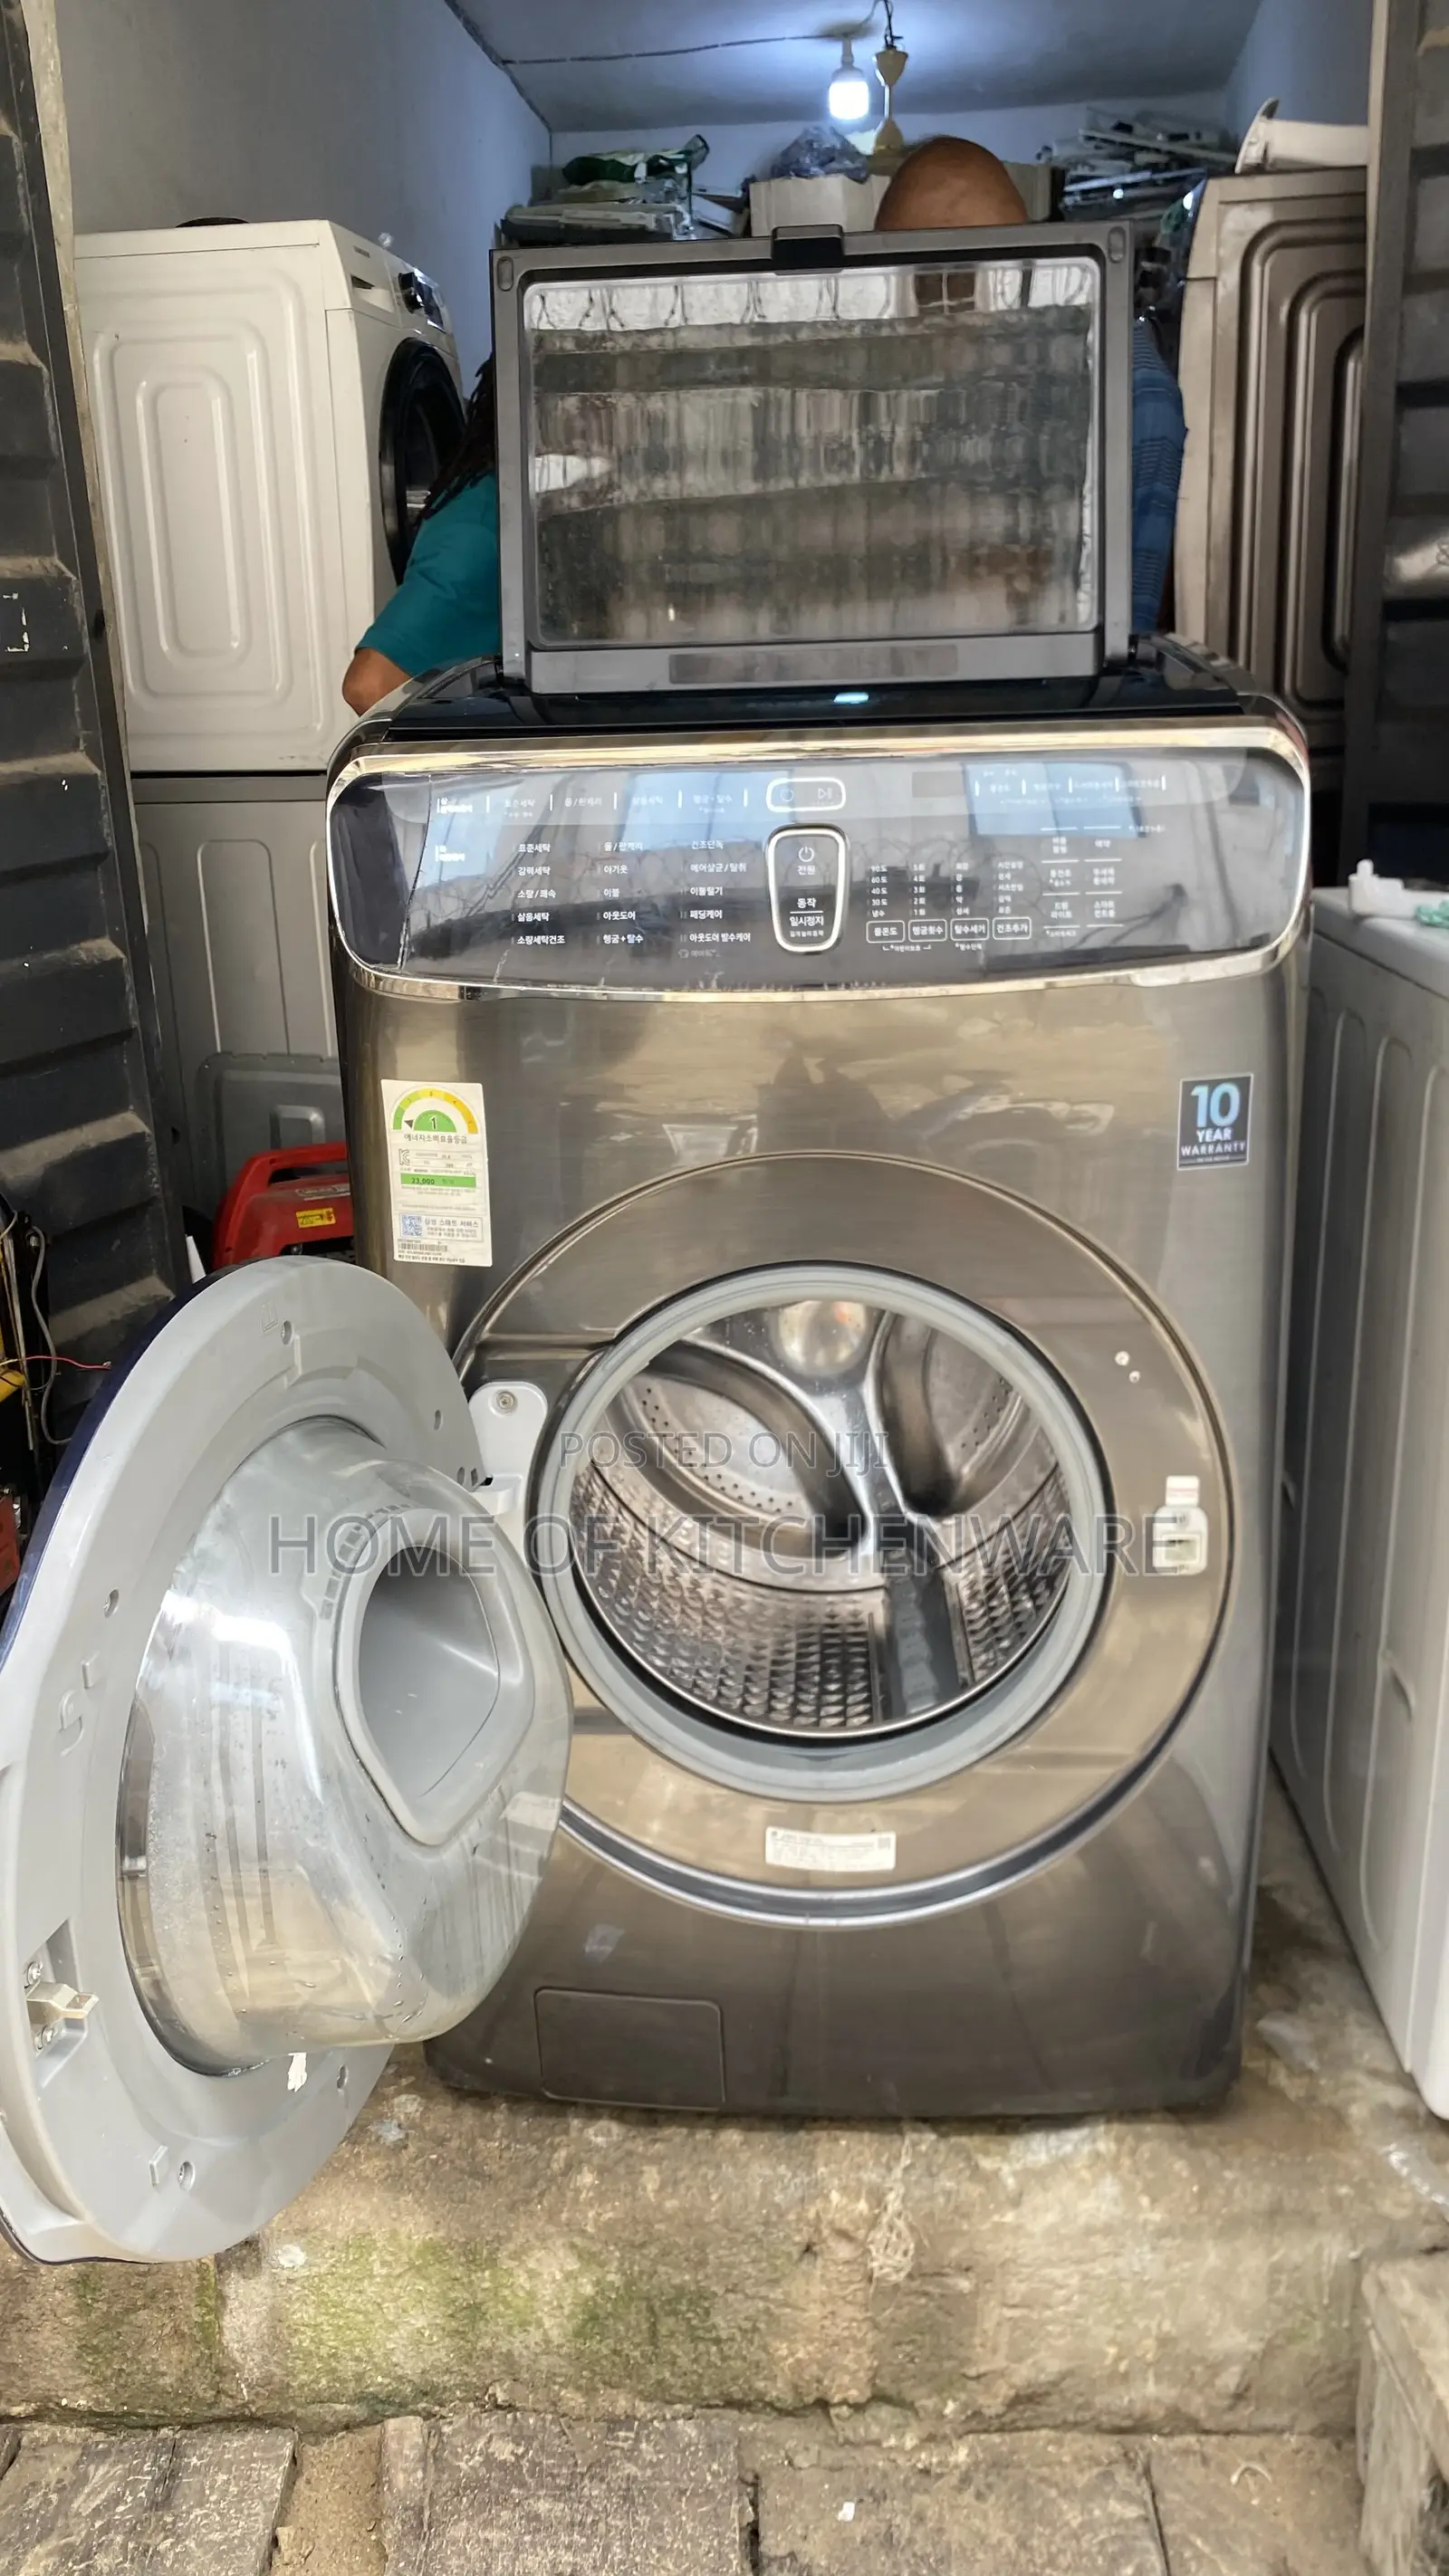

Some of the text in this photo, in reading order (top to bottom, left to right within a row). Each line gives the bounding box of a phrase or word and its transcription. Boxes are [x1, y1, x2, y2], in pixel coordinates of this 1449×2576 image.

[518, 843, 551, 853] 표준세탁
[692, 839, 724, 849] 건조단독
[518, 866, 551, 876] 강력세탁
[603, 866, 629, 875] 아기옷
[797, 865, 816, 876] 전원
[604, 888, 619, 897] 이불
[690, 886, 724, 896] 이불털기
[797, 898, 817, 908] 동작
[603, 911, 637, 921] 아웃도어
[689, 910, 723, 919] 패딩케어
[789, 915, 824, 927] 일시정지
[996, 922, 1029, 934] 건조추가
[517, 934, 565, 945] 소량세탁건조
[689, 933, 751, 943] 아웃도어 발수케어
[1190, 1082, 1241, 1128] 10
[1195, 1126, 1233, 1143] YEAR
[1180, 1141, 1246, 1157] WARRANTY
[411, 1177, 435, 1185] 23,000
